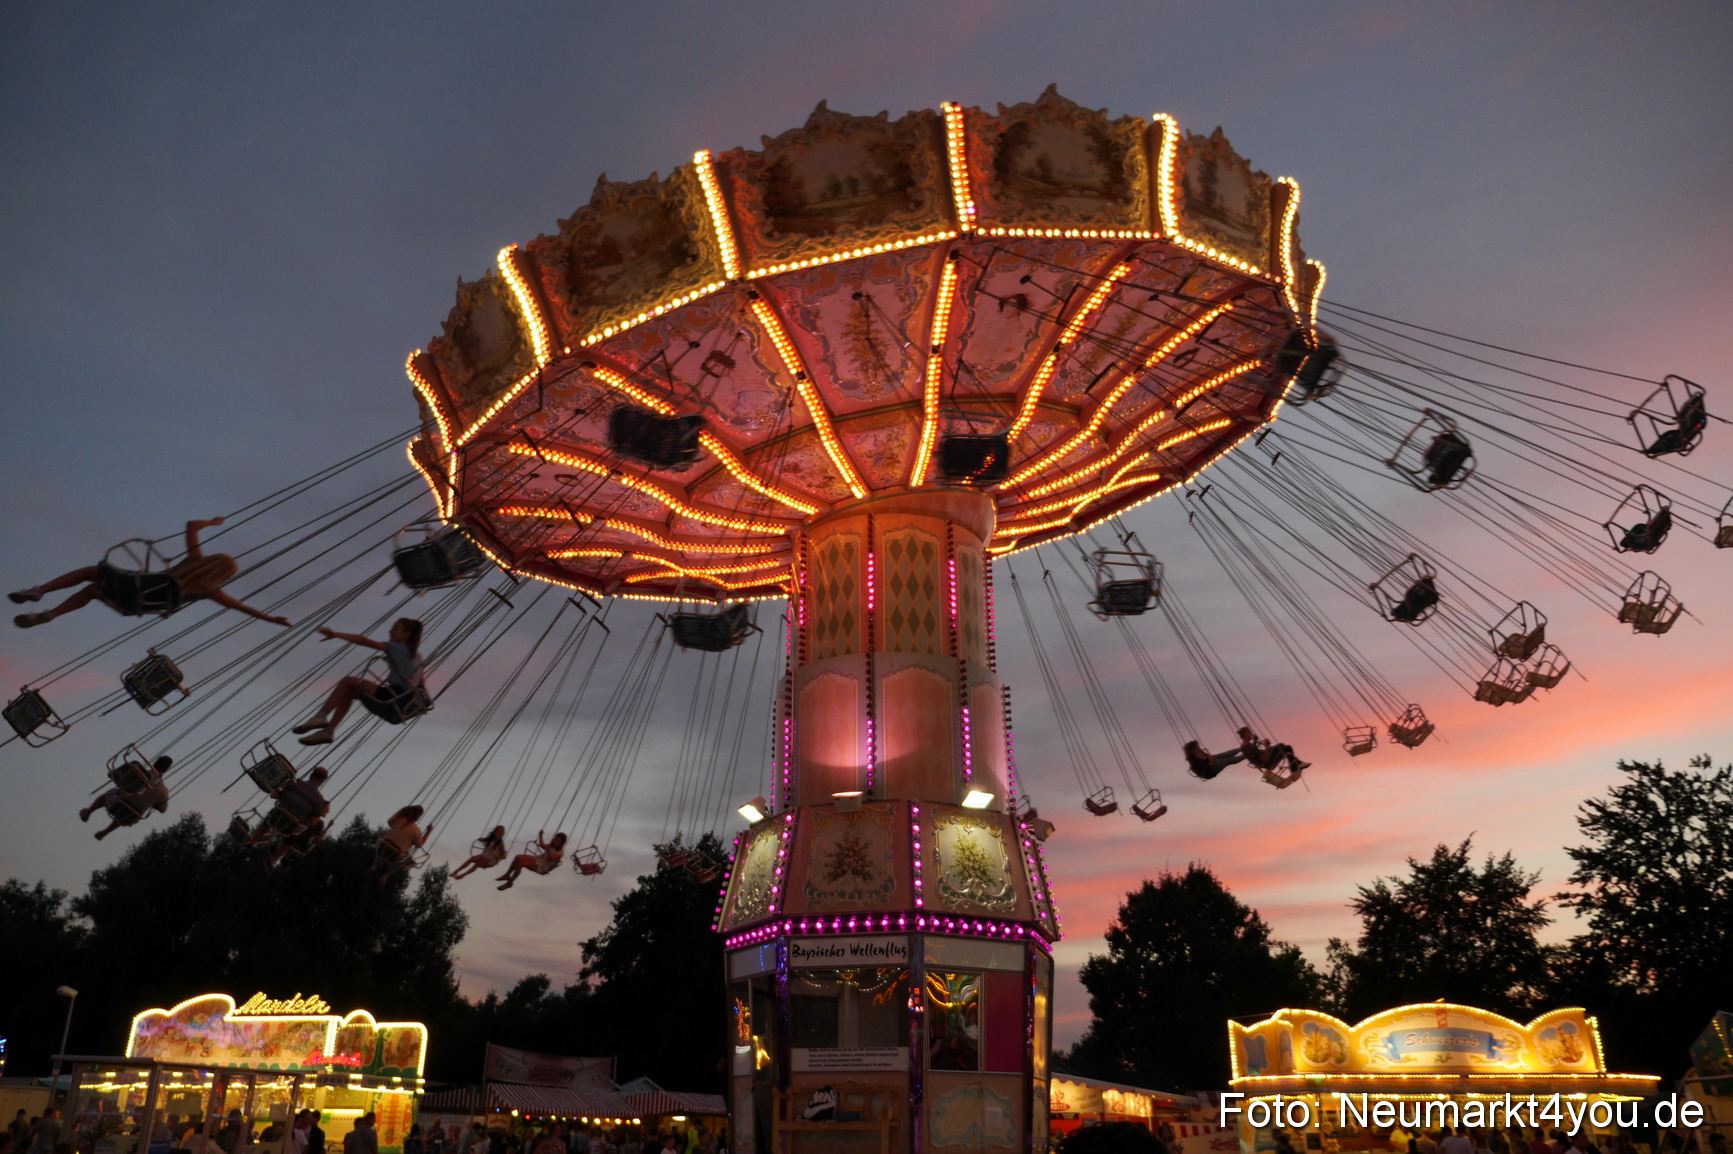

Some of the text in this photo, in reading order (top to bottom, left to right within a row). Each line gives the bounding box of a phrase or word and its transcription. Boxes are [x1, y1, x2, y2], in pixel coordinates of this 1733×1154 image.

[792, 941, 908, 960] Bayrischer Wellenflug
[233, 991, 330, 1015] Mandeln
